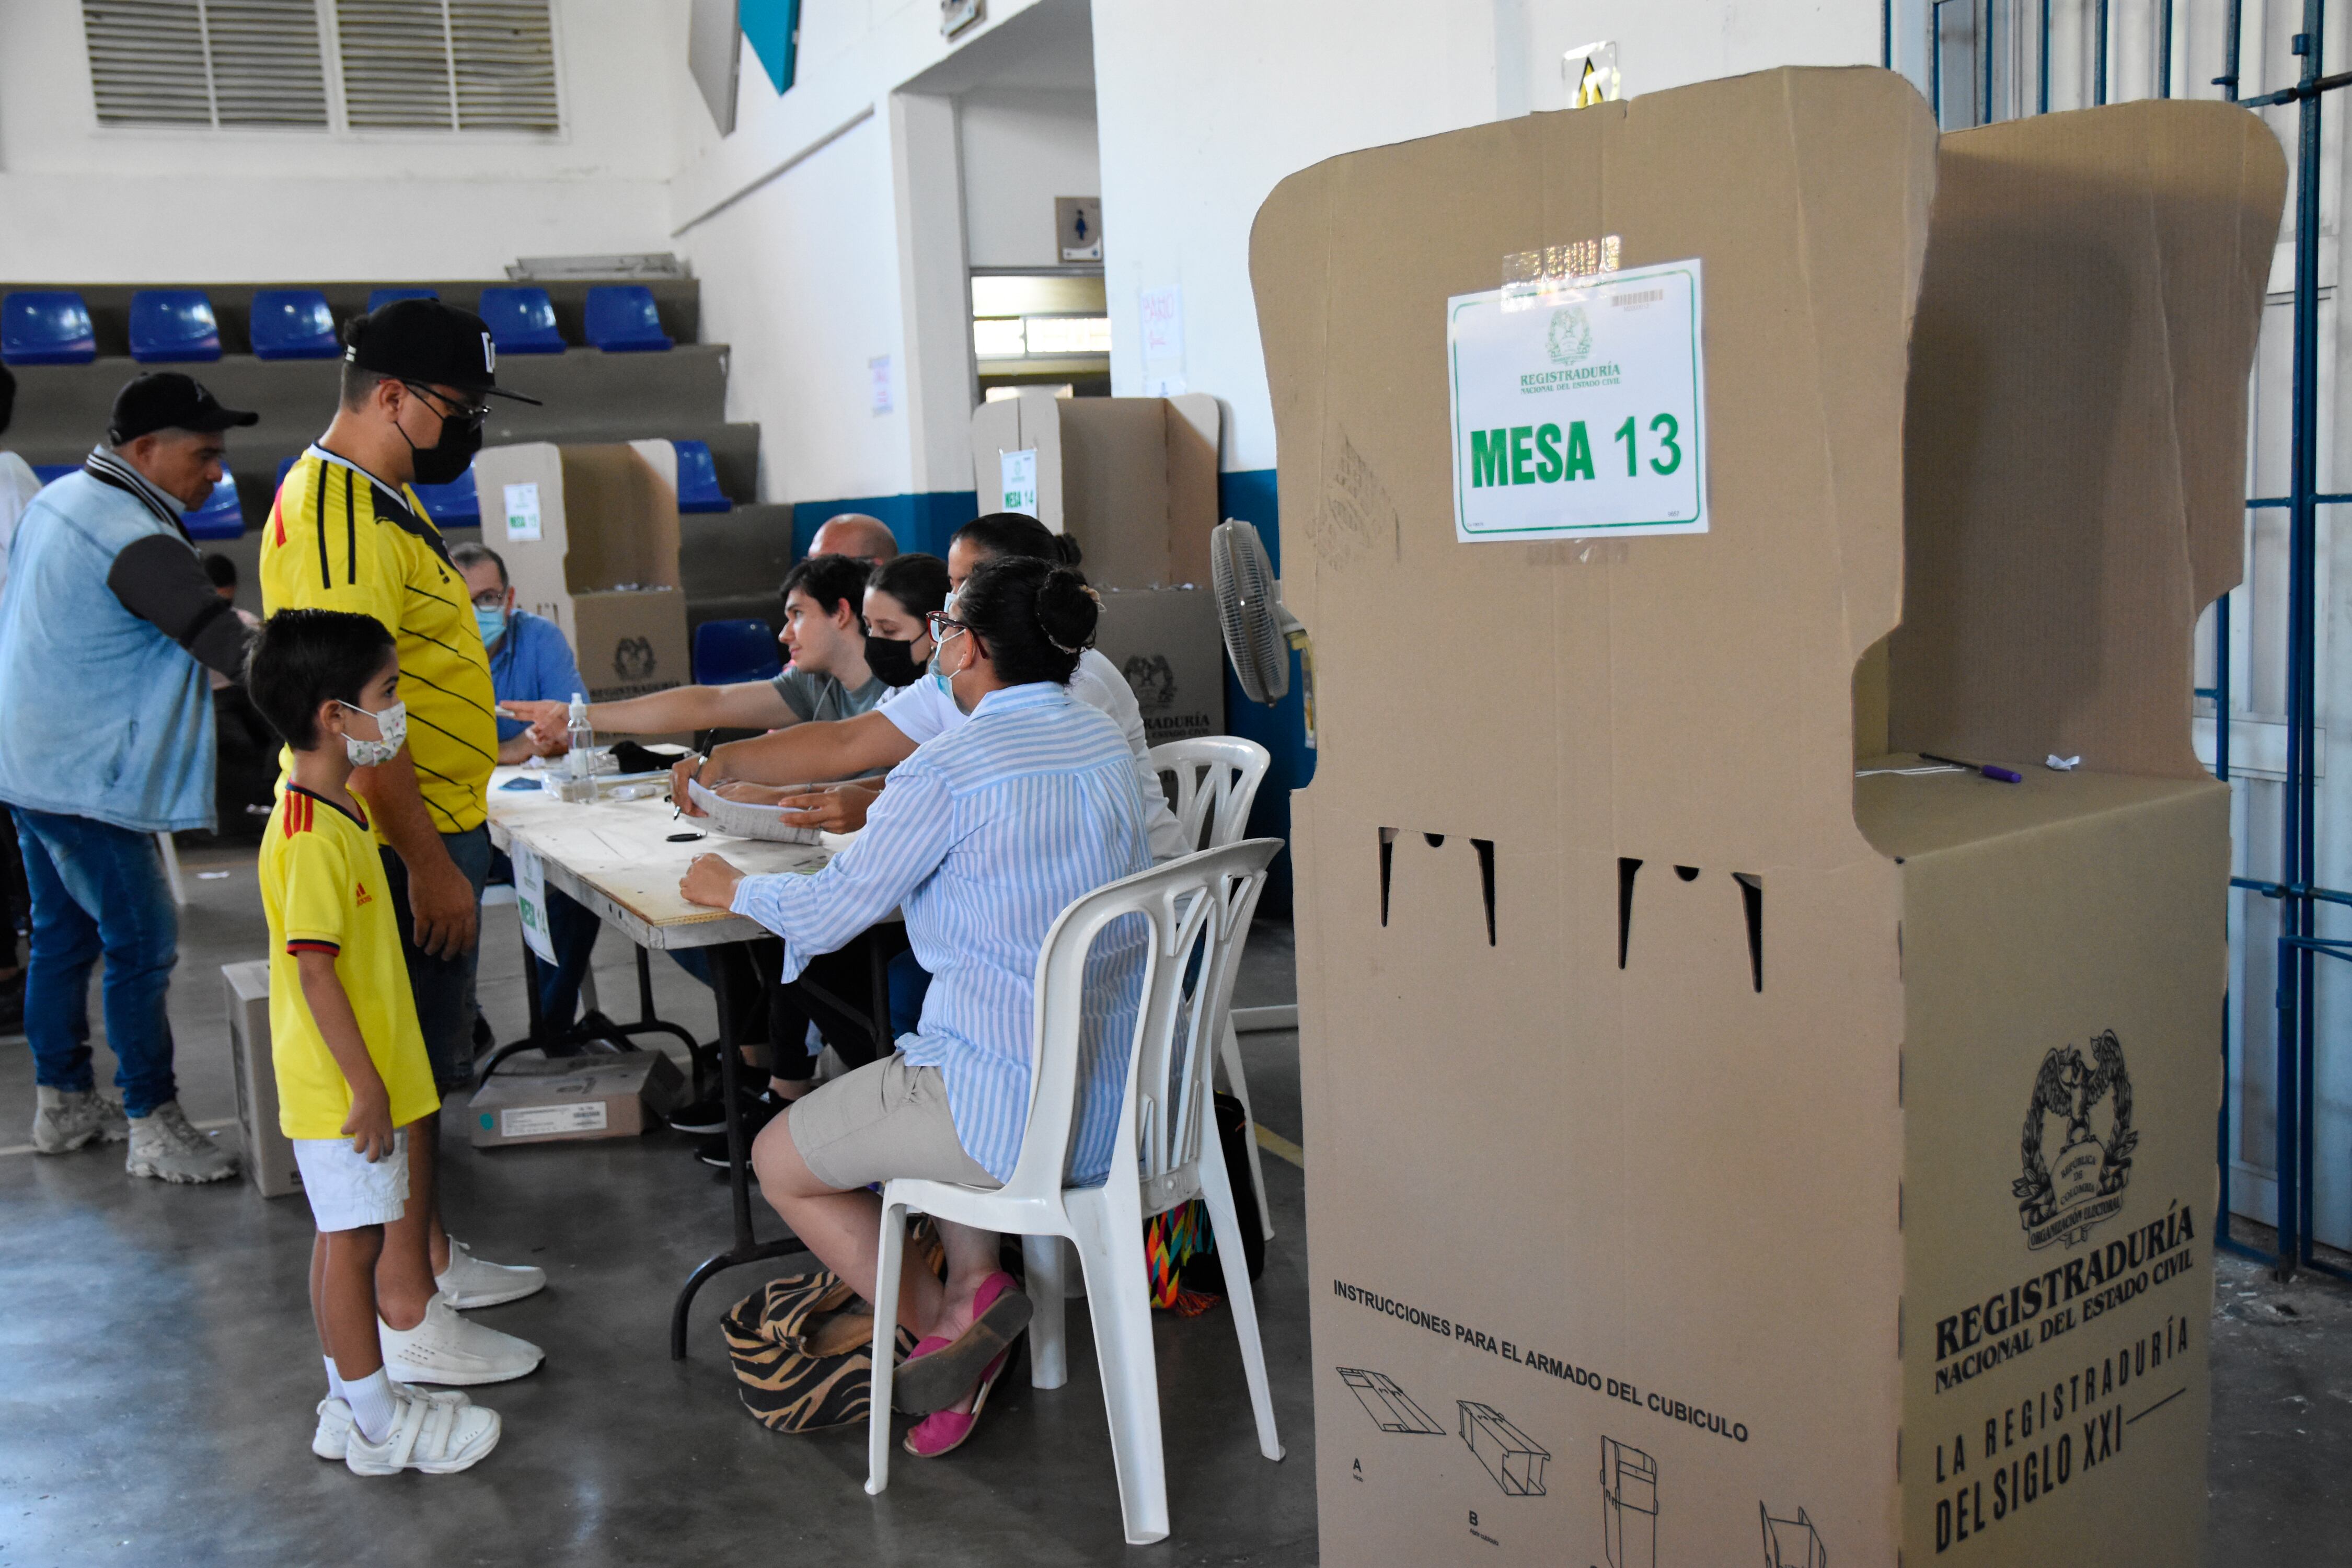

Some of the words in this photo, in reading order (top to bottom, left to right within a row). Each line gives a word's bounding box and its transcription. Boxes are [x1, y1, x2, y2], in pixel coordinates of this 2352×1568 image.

[1520, 361, 1620, 386] REGISTRADURÍA
[1520, 385, 1554, 395] NACIONAL
[1573, 379, 1600, 389] ESTADO
[1470, 420, 1596, 488] MESA
[1615, 413, 1681, 477] 13
[1144, 711, 1210, 729] RADURÍA
[2060, 1183, 2094, 1205] COLOMBIA
[2073, 1170, 2083, 1181] DE
[2031, 1207, 2083, 1246] ORGANIZACIÓN
[2083, 1196, 2120, 1220] ELECTORAL
[1935, 1198, 2195, 1362] REGISTRADURÍA
[1935, 1328, 2033, 1394] NACIONAL
[2040, 1307, 2077, 1343] DEL
[2082, 1271, 2148, 1323] ESTADO
[2152, 1248, 2193, 1285] CIVIL
[1333, 1279, 1450, 1336] INSTRUCCIONES
[1455, 1323, 1498, 1354] PARA
[1502, 1340, 1521, 1364] EL
[1525, 1350, 1601, 1391] ARMADO
[1607, 1377, 1642, 1406] DEL
[1647, 1392, 1749, 1443] CUBICULO
[1935, 1434, 1966, 1484] LA
[1986, 1315, 2188, 1458] REGISTRADURÍA
[1353, 1458, 1362, 1472] A
[1935, 1480, 1985, 1554] DEL
[1993, 1433, 2071, 1520] SIGLO
[2083, 1403, 2122, 1472] XXI
[1469, 1510, 1478, 1526] B
